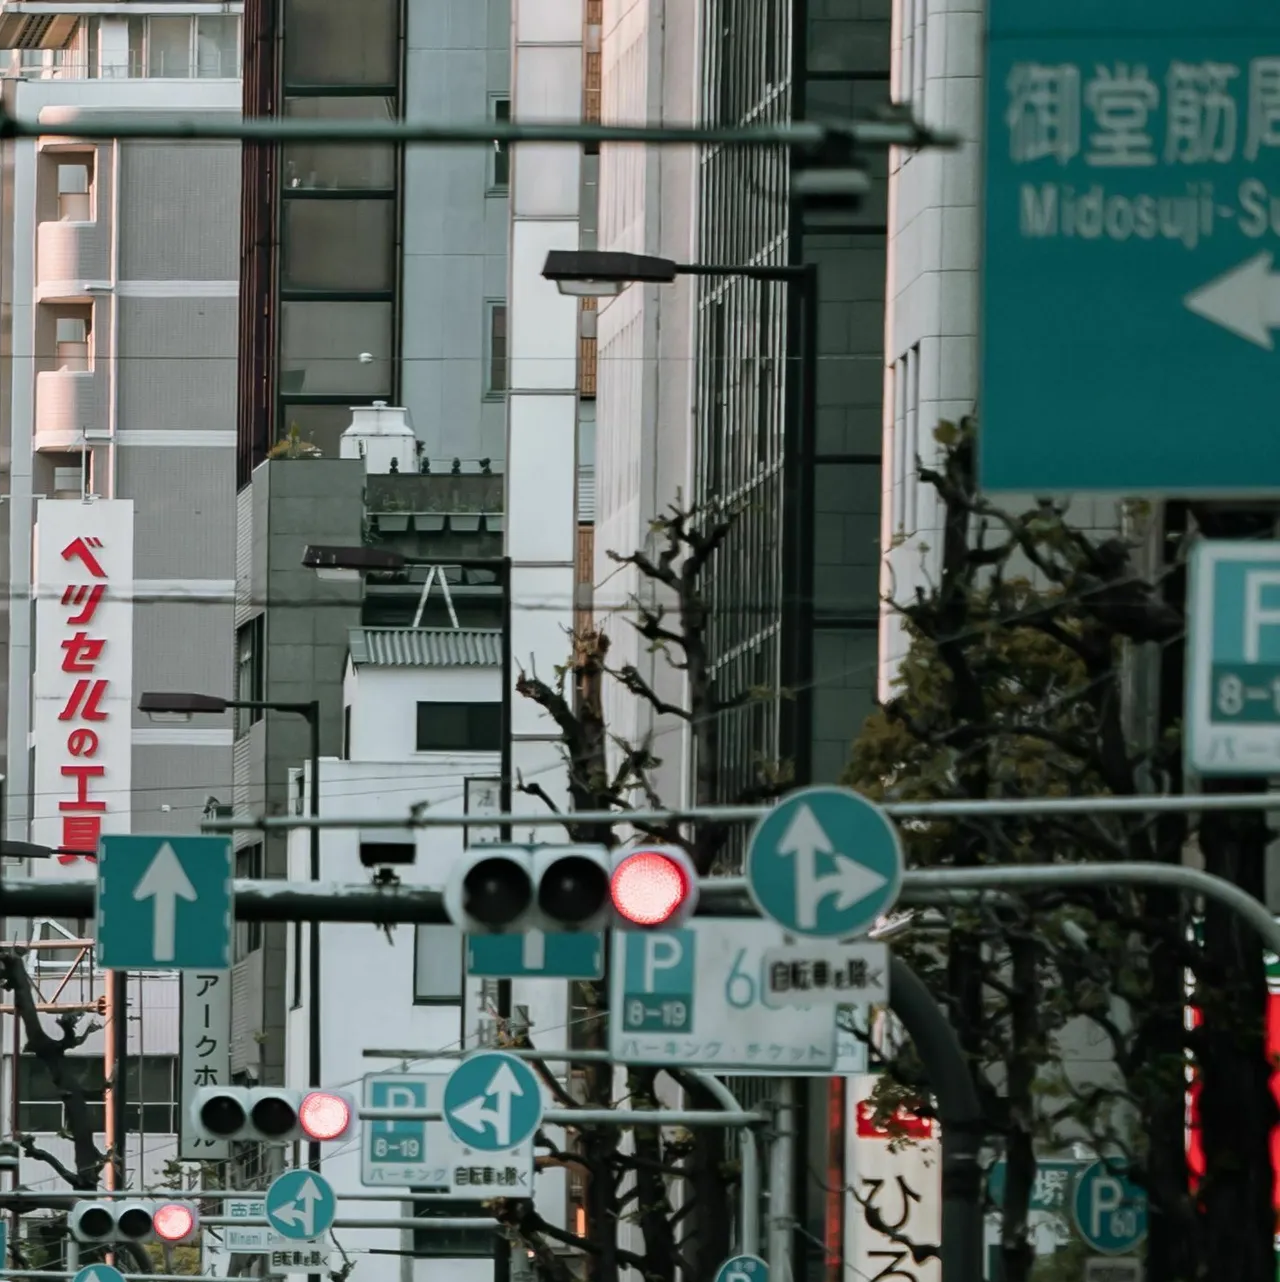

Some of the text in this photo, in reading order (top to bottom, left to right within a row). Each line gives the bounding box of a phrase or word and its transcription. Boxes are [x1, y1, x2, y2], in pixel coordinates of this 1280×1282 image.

[1020, 177, 1280, 249] Midosuji-S
[644, 934, 683, 993] P
[770, 958, 885, 993] 自転車を除く
[193, 973, 219, 1148] アークホル
[386, 1086, 416, 1132] P
[453, 1166, 528, 1187] 自転車を除く
[1090, 1180, 1122, 1239] P
[272, 1250, 329, 1268] 自転車を除く
